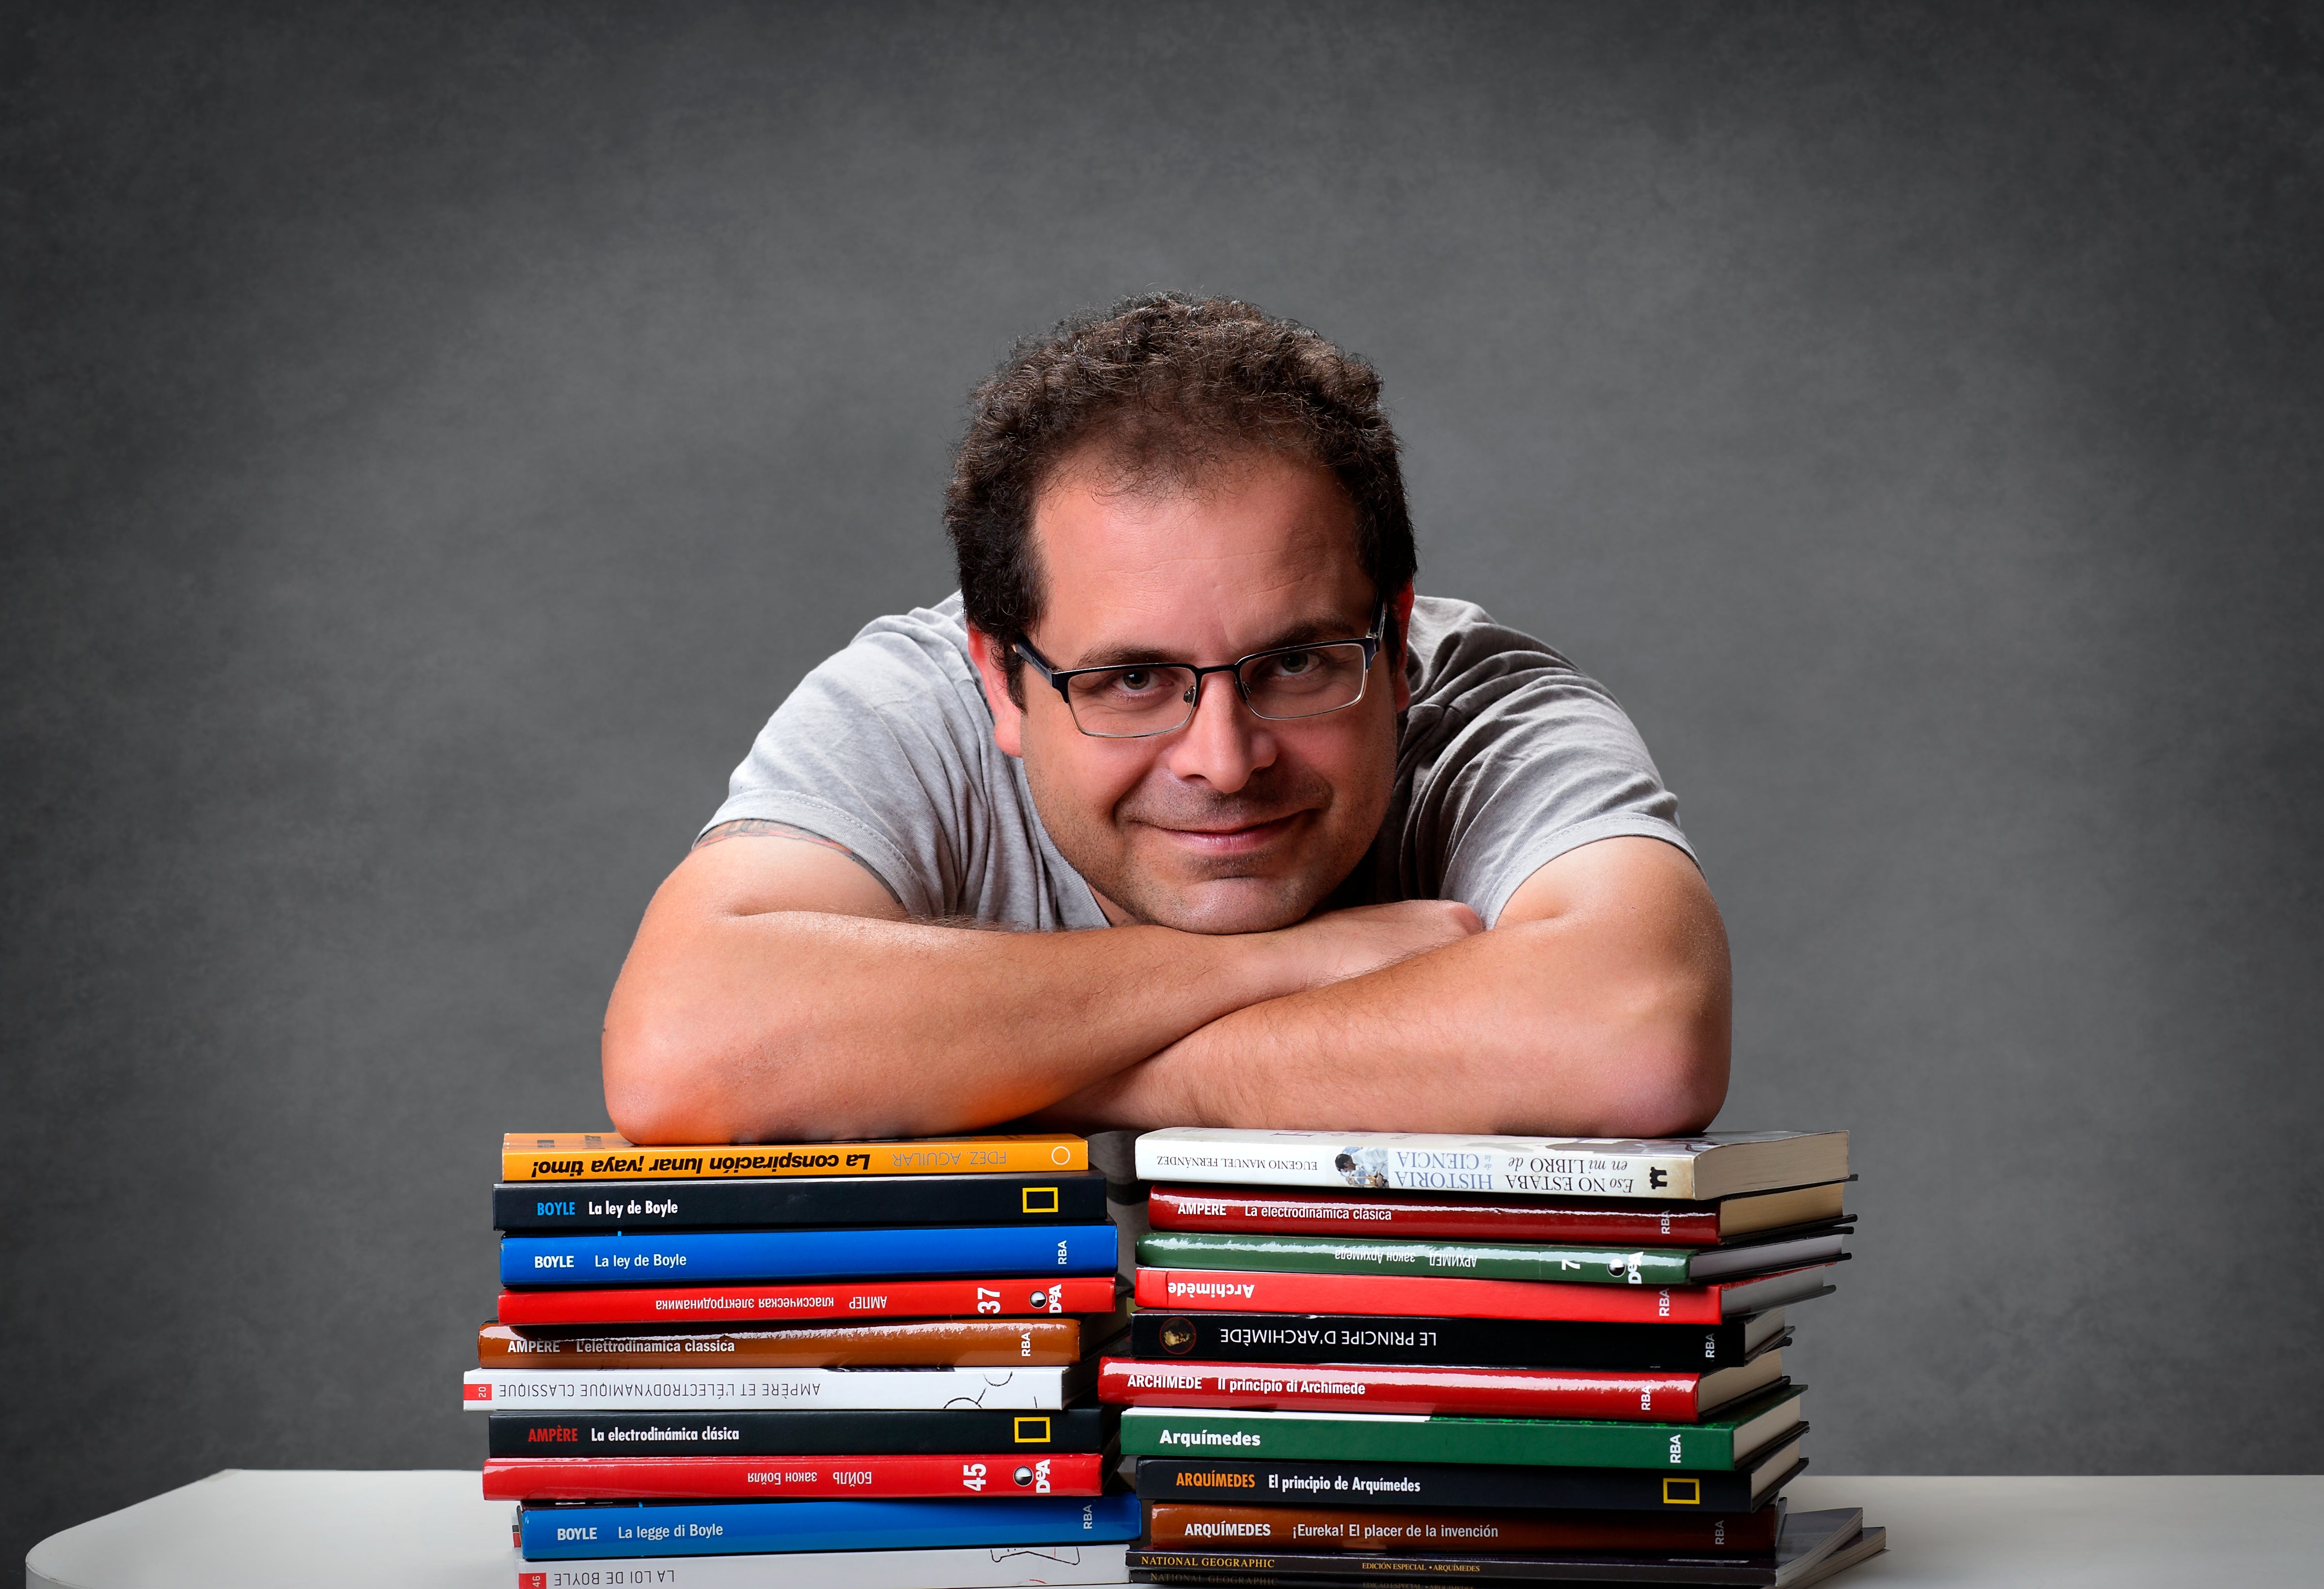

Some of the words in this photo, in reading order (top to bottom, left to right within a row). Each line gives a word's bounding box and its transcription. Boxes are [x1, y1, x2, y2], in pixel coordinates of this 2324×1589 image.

[591, 1156, 644, 1172] ¡vaya
[649, 1158, 703, 1173] lunar
[710, 1152, 839, 1173] conspiración
[846, 1154, 870, 1170] La
[892, 1152, 959, 1166] AGUILAR
[966, 1151, 1006, 1164] FDEZ.
[1157, 1156, 1218, 1169] FERNÁNDEZ
[1220, 1158, 1265, 1169] MANUEL
[1268, 1160, 1317, 1170] EUGENIO
[1396, 1151, 1479, 1170] CIENCIA
[1509, 1157, 1524, 1171] de
[1530, 1158, 1583, 1173] LIBRO
[1612, 1161, 1627, 1170] en
[531, 1160, 584, 1178] timo!
[1588, 1160, 1607, 1174] mi
[1396, 1171, 1494, 1190] HISTORIA
[1505, 1174, 1573, 1191] ESTABA
[1579, 1177, 1605, 1192] NO
[1609, 1178, 1634, 1193] Eso
[537, 1202, 575, 1215] BOYLE
[589, 1201, 603, 1215] La
[606, 1201, 623, 1218] ley
[627, 1200, 641, 1214] de
[645, 1199, 678, 1217] Boyle
[1178, 1199, 1226, 1216] AMPÈRE
[1245, 1204, 1257, 1217] La
[1261, 1205, 1349, 1220] electrodinámica
[1353, 1206, 1391, 1221] clásica
[1661, 1210, 1670, 1234] RBA
[1058, 1240, 1067, 1265] RBA
[1335, 1249, 1384, 1264] Архимеда
[1387, 1252, 1416, 1262] закон
[1430, 1251, 1477, 1267] АРХИМЕД
[534, 1256, 574, 1268] BOYLE
[595, 1255, 608, 1267] La
[613, 1254, 630, 1269] ley
[634, 1254, 649, 1266] de
[654, 1254, 686, 1268] Boyle
[1561, 1259, 1580, 1270] 7
[1628, 1252, 1644, 1284] DeA
[1168, 1282, 1255, 1298] Archimède
[655, 1297, 754, 1310] электродинамика
[759, 1297, 834, 1307] классическая
[849, 1296, 887, 1309] АМПЕР
[977, 1287, 1000, 1314] 37
[1049, 1284, 1061, 1313] DeA
[1659, 1288, 1670, 1317] RBA
[685, 1339, 735, 1352] classica
[1021, 1332, 1030, 1356] RBA
[1220, 1328, 1336, 1347] D'ARCHIMÈDE
[1341, 1331, 1414, 1346] PRINCIPE
[1419, 1332, 1436, 1346] LE
[1705, 1333, 1715, 1358] RBA
[740, 1384, 756, 1396] ET
[1127, 1374, 1202, 1390] ARCHIMEDE
[1217, 1378, 1227, 1390] Il
[1230, 1378, 1283, 1394] principio
[1286, 1380, 1298, 1392] di
[1301, 1381, 1365, 1395] Archimede
[478, 1386, 486, 1399] 20
[499, 1384, 575, 1398] CLASSIQUE
[580, 1384, 735, 1400] L'ÉLECTRODYNAMIQUE
[762, 1383, 820, 1399] AMPÈRE
[1641, 1385, 1651, 1411] RBA
[528, 1425, 577, 1442] AMPÈRE
[592, 1428, 604, 1441] La
[608, 1427, 698, 1442] electrodinámica
[702, 1426, 739, 1440] clásica
[1159, 1430, 1261, 1448] Arquímedes
[1670, 1434, 1681, 1463] RBA
[748, 1472, 781, 1485] Бойля
[785, 1472, 817, 1482] закон
[832, 1471, 872, 1487] БОЙЛЬ
[963, 1463, 986, 1491] 45
[1036, 1459, 1050, 1494] DeA
[1176, 1470, 1255, 1489] ARQUÍMEDES
[1268, 1474, 1279, 1489] El
[1282, 1475, 1331, 1492] principio
[1334, 1476, 1348, 1490] de
[1352, 1476, 1420, 1494] Arquímedes
[1083, 1505, 1093, 1529] RBA
[557, 1527, 597, 1542] BOYLE
[618, 1526, 632, 1539] La
[636, 1525, 671, 1542] legge
[674, 1524, 686, 1537] di
[690, 1524, 723, 1539] Boyle
[1184, 1521, 1271, 1537] ARQUÍMEDES
[1293, 1524, 1343, 1540] ¡Eureka!
[1349, 1524, 1360, 1537] El
[1364, 1524, 1403, 1540] placer
[1406, 1524, 1421, 1538] de
[1426, 1525, 1437, 1538] la
[1441, 1524, 1498, 1538] invención
[1715, 1520, 1725, 1545] RBA
[1141, 1556, 1198, 1566] NATIONAL
[1201, 1558, 1275, 1568] GEOGRAPHIC
[1433, 1564, 1480, 1572] ARQUÍMEDES
[532, 1575, 540, 1588] 46
[554, 1573, 599, 1586] BOYLE
[606, 1572, 623, 1584] DE
[630, 1571, 651, 1584] LOI
[657, 1570, 674, 1583] LA
[1151, 1573, 1204, 1583] NATIONAL
[1208, 1576, 1278, 1586] GEOGRAPHIC
